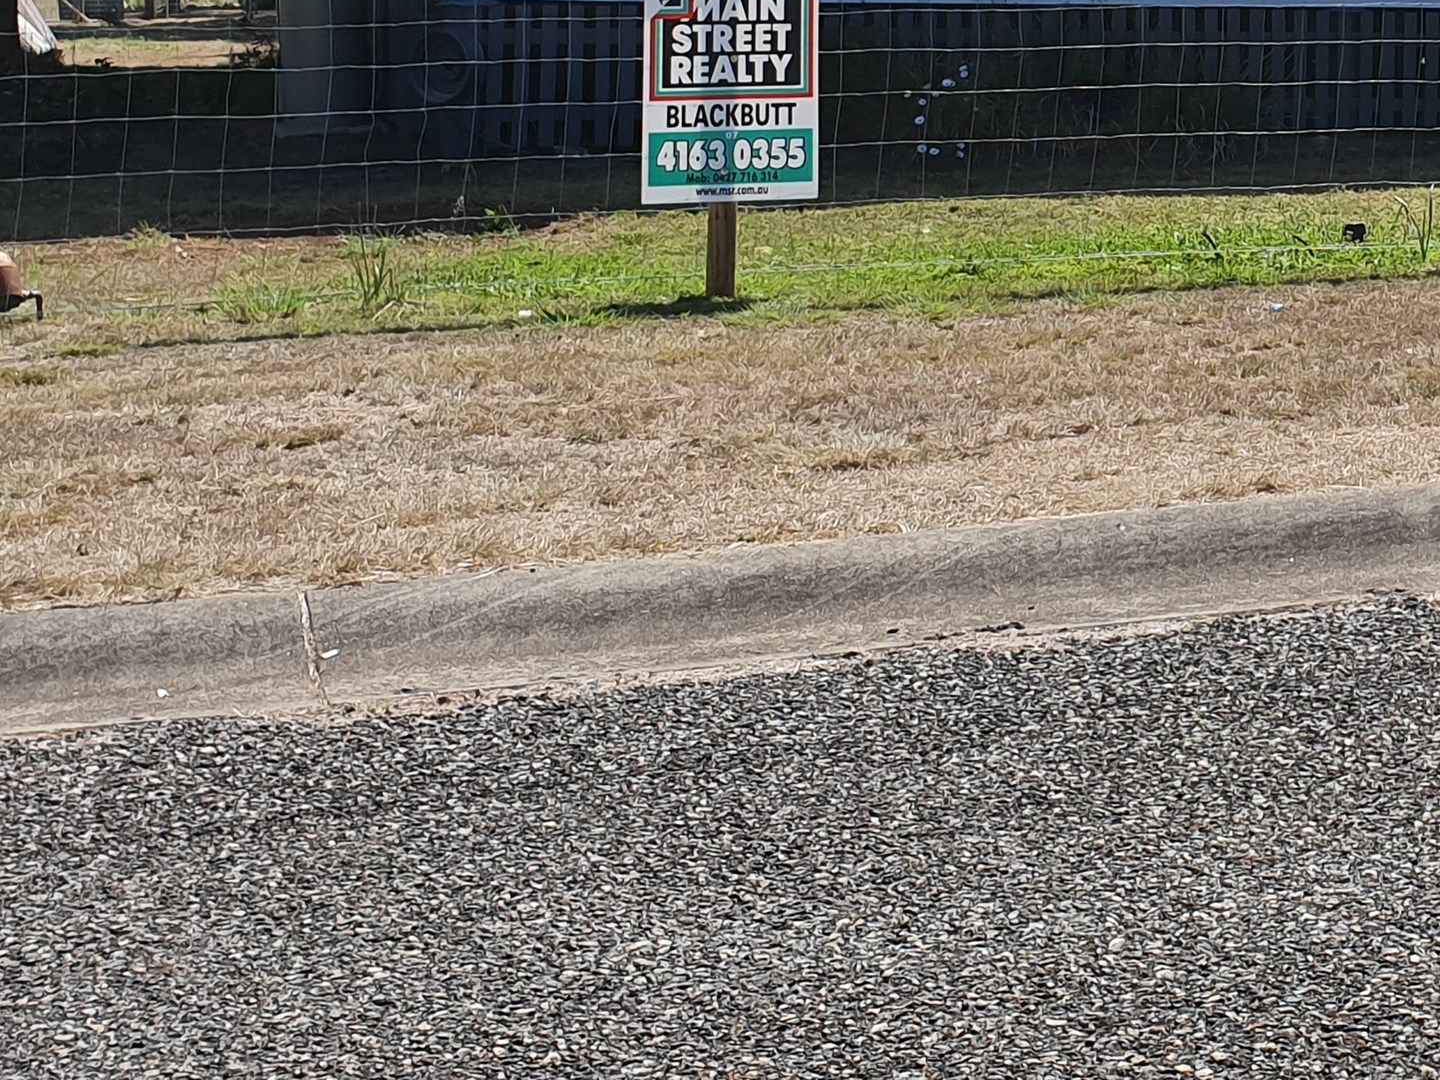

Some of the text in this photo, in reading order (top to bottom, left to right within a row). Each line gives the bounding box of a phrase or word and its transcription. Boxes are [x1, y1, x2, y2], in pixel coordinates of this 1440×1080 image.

[671, 23, 792, 54] STREET
[670, 53, 793, 85] REALTY
[666, 102, 797, 128] BLACKBUTT
[656, 136, 806, 172] 4163 0355
[685, 173, 710, 184] Mob:
[695, 185, 769, 196] www.msr.com.au
